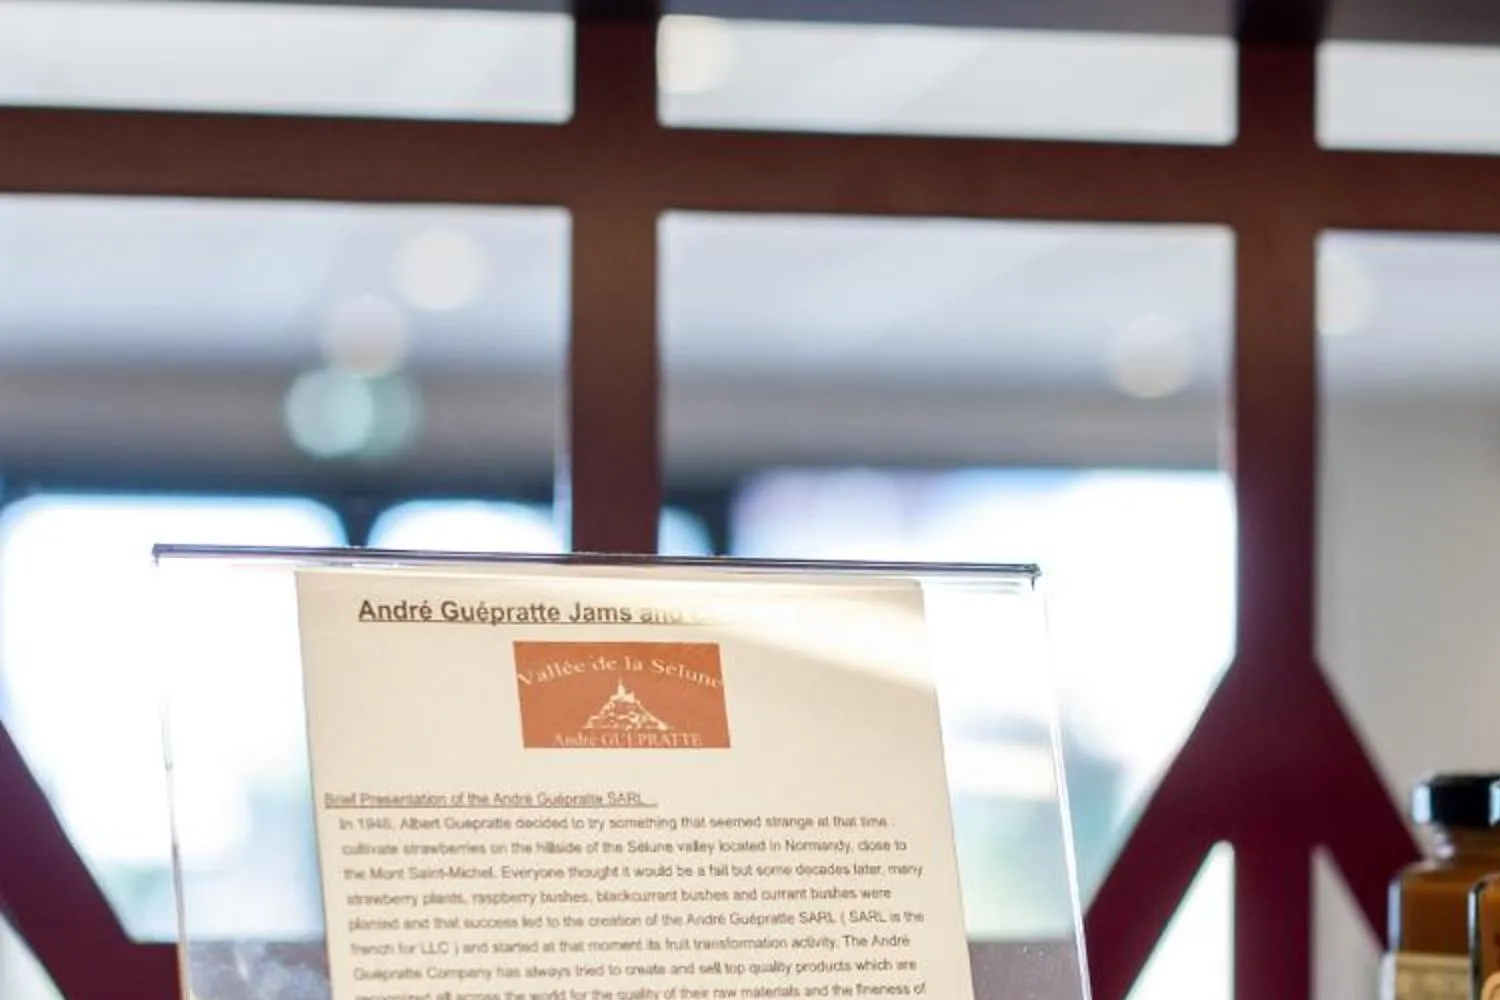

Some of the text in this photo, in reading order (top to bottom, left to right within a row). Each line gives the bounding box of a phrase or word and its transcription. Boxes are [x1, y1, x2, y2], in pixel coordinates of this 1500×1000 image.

[358, 599, 433, 622] André
[441, 600, 560, 626] Guépratte
[569, 602, 632, 623] Jams
[518, 655, 725, 689] Vallée de la Sélune
[323, 792, 357, 809] Brief
[358, 792, 449, 809] Presentation
[606, 790, 643, 808] SARL
[369, 866, 405, 881] Mont
[500, 865, 566, 881] Everyone
[567, 865, 620, 881] thought
[633, 864, 674, 878] would
[755, 865, 793, 878] some
[794, 863, 851, 877] decades
[887, 864, 924, 878] many
[346, 893, 419, 908] strawberry
[471, 891, 537, 907] raspberry
[595, 889, 678, 903] blackcurrant
[680, 888, 730, 902] bushes
[732, 887, 758, 902] and
[760, 888, 808, 901] currant
[809, 886, 858, 901] bushes
[859, 888, 892, 900] were
